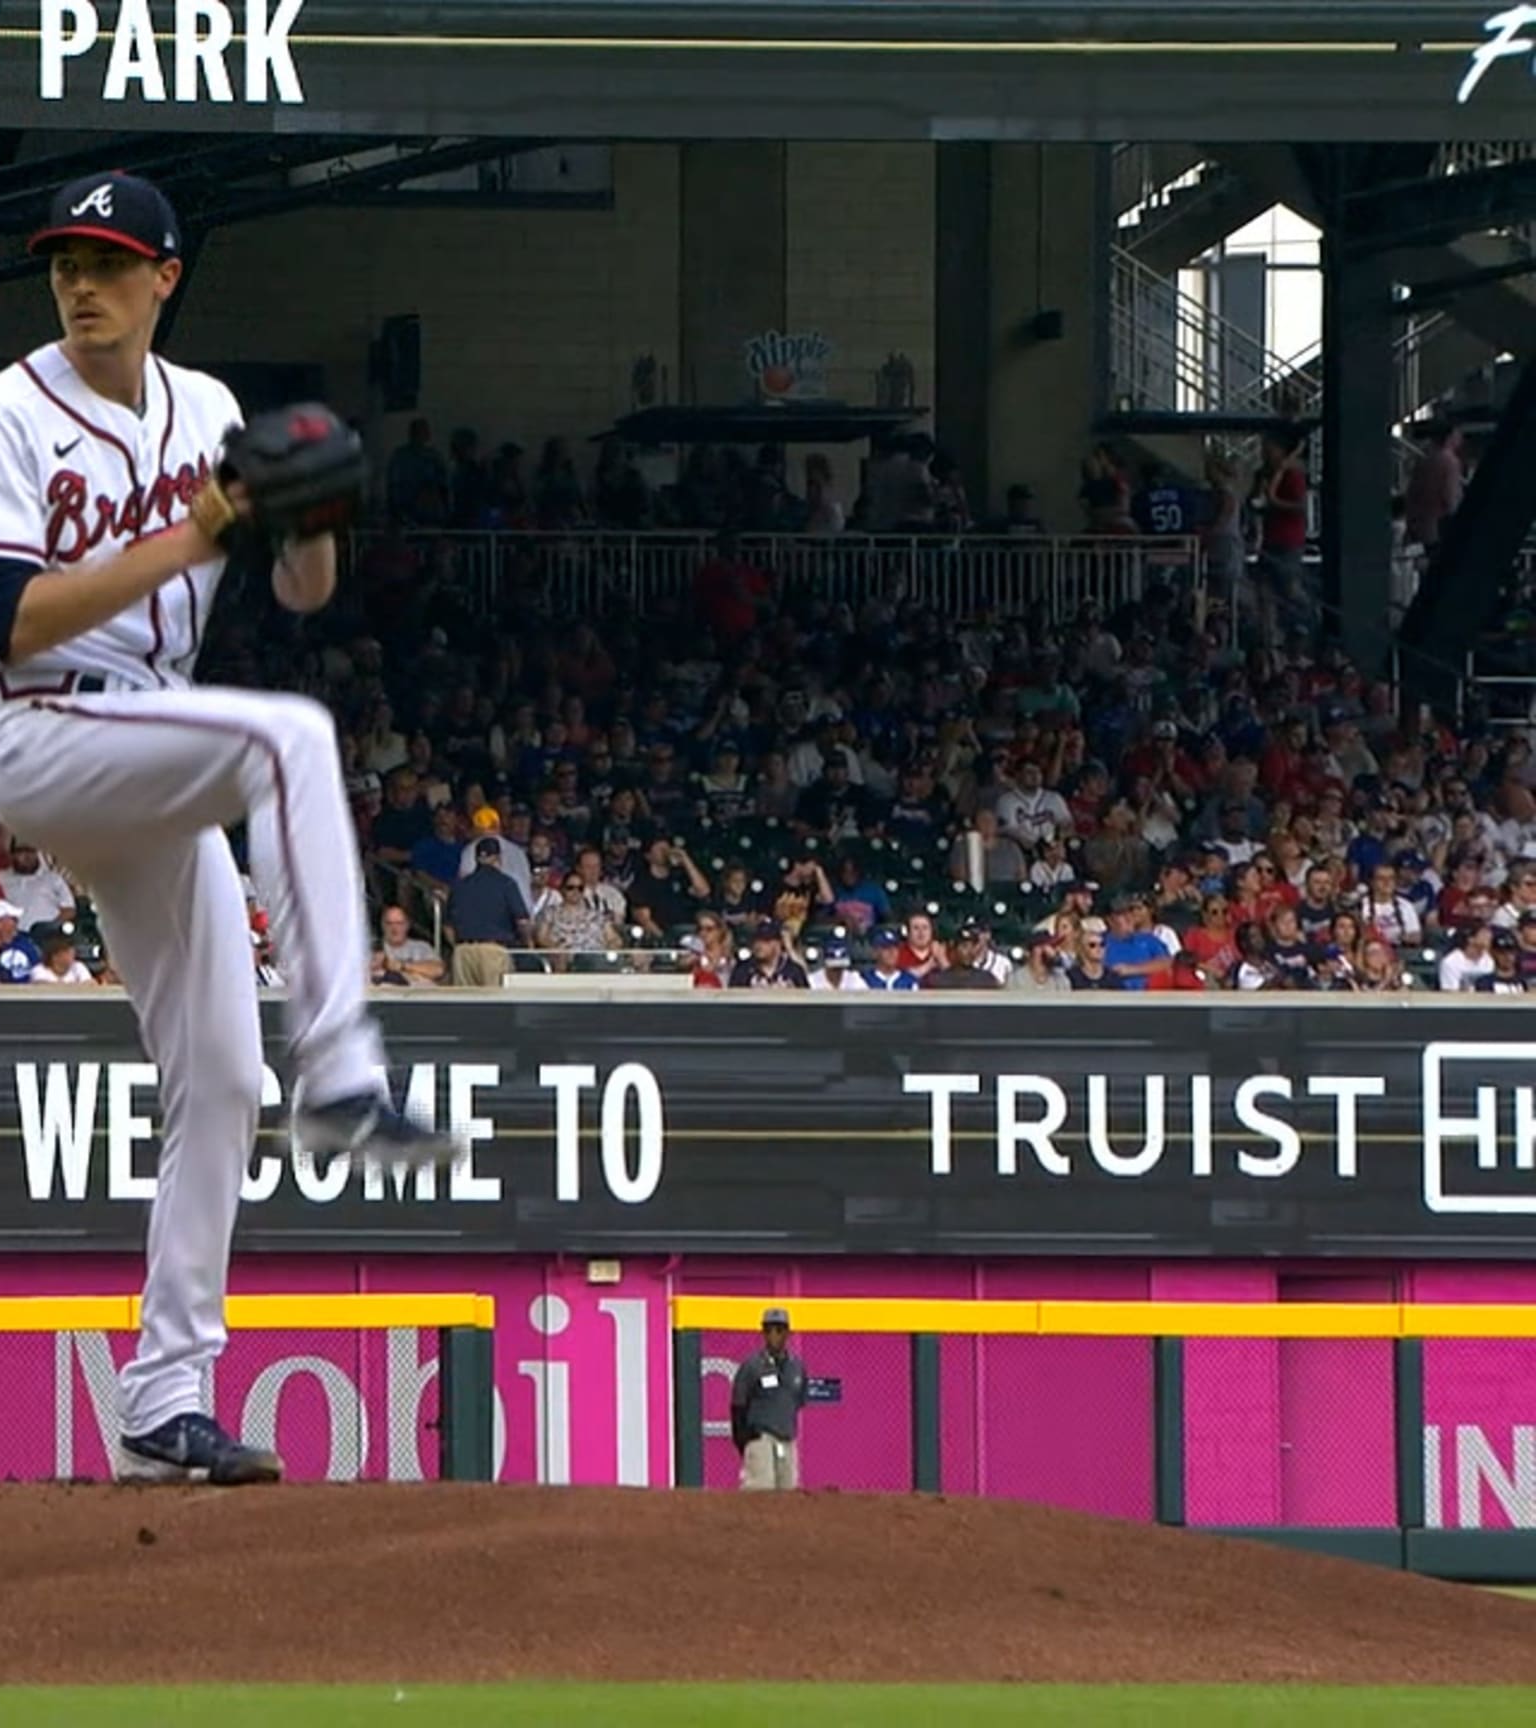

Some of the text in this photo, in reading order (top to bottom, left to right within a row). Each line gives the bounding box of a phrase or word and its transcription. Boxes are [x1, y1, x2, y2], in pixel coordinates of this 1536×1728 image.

[40, 0, 304, 102] PARK
[1151, 503, 1183, 533] 50
[16, 1062, 664, 1203] WECOME TO
[903, 1074, 1385, 1177] TRUIST
